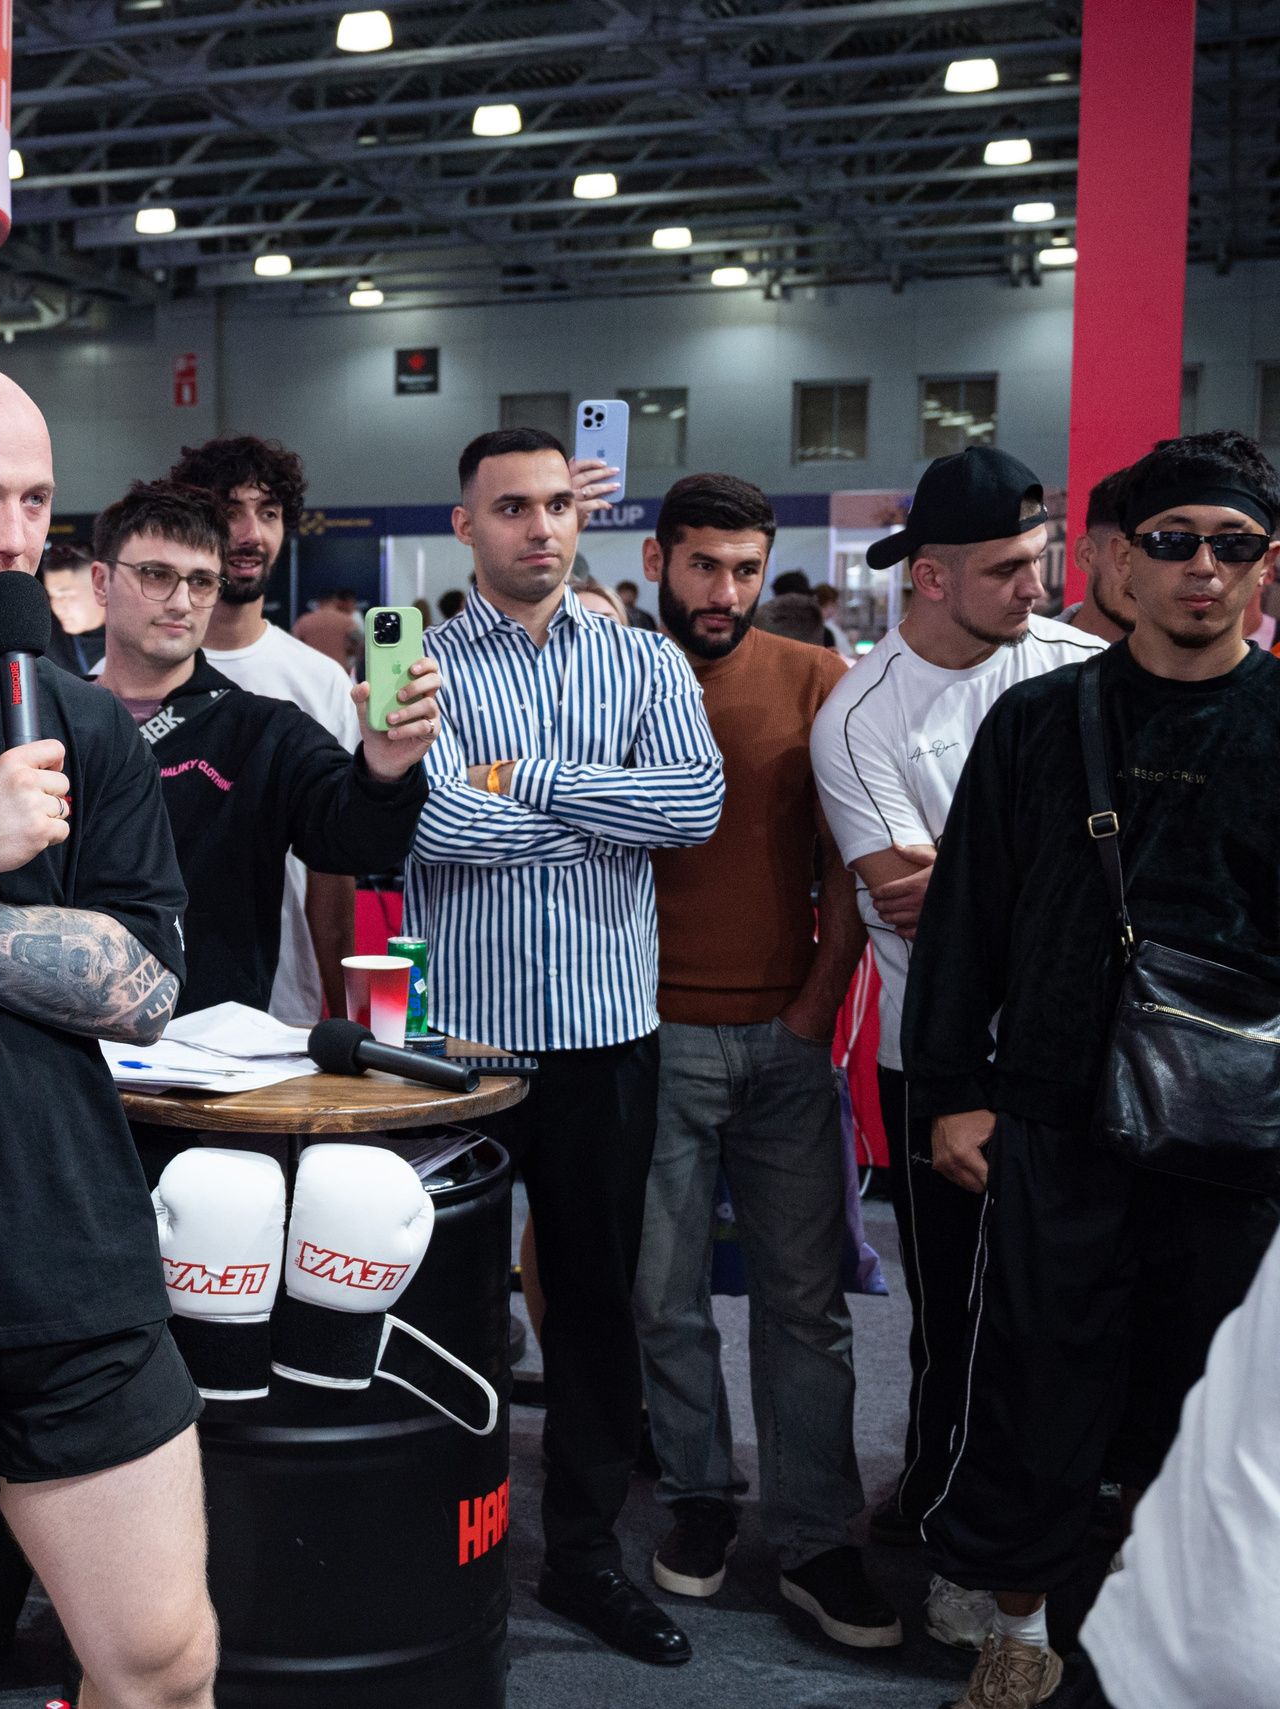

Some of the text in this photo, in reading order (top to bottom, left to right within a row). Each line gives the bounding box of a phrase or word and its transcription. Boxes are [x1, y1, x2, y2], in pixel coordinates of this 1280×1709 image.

[590, 505, 645, 526] LLUP
[9, 661, 22, 705] HARDCORE
[161, 1256, 270, 1295] LEWA
[298, 1241, 411, 1291] LEWA
[458, 1474, 510, 1566] HAR
